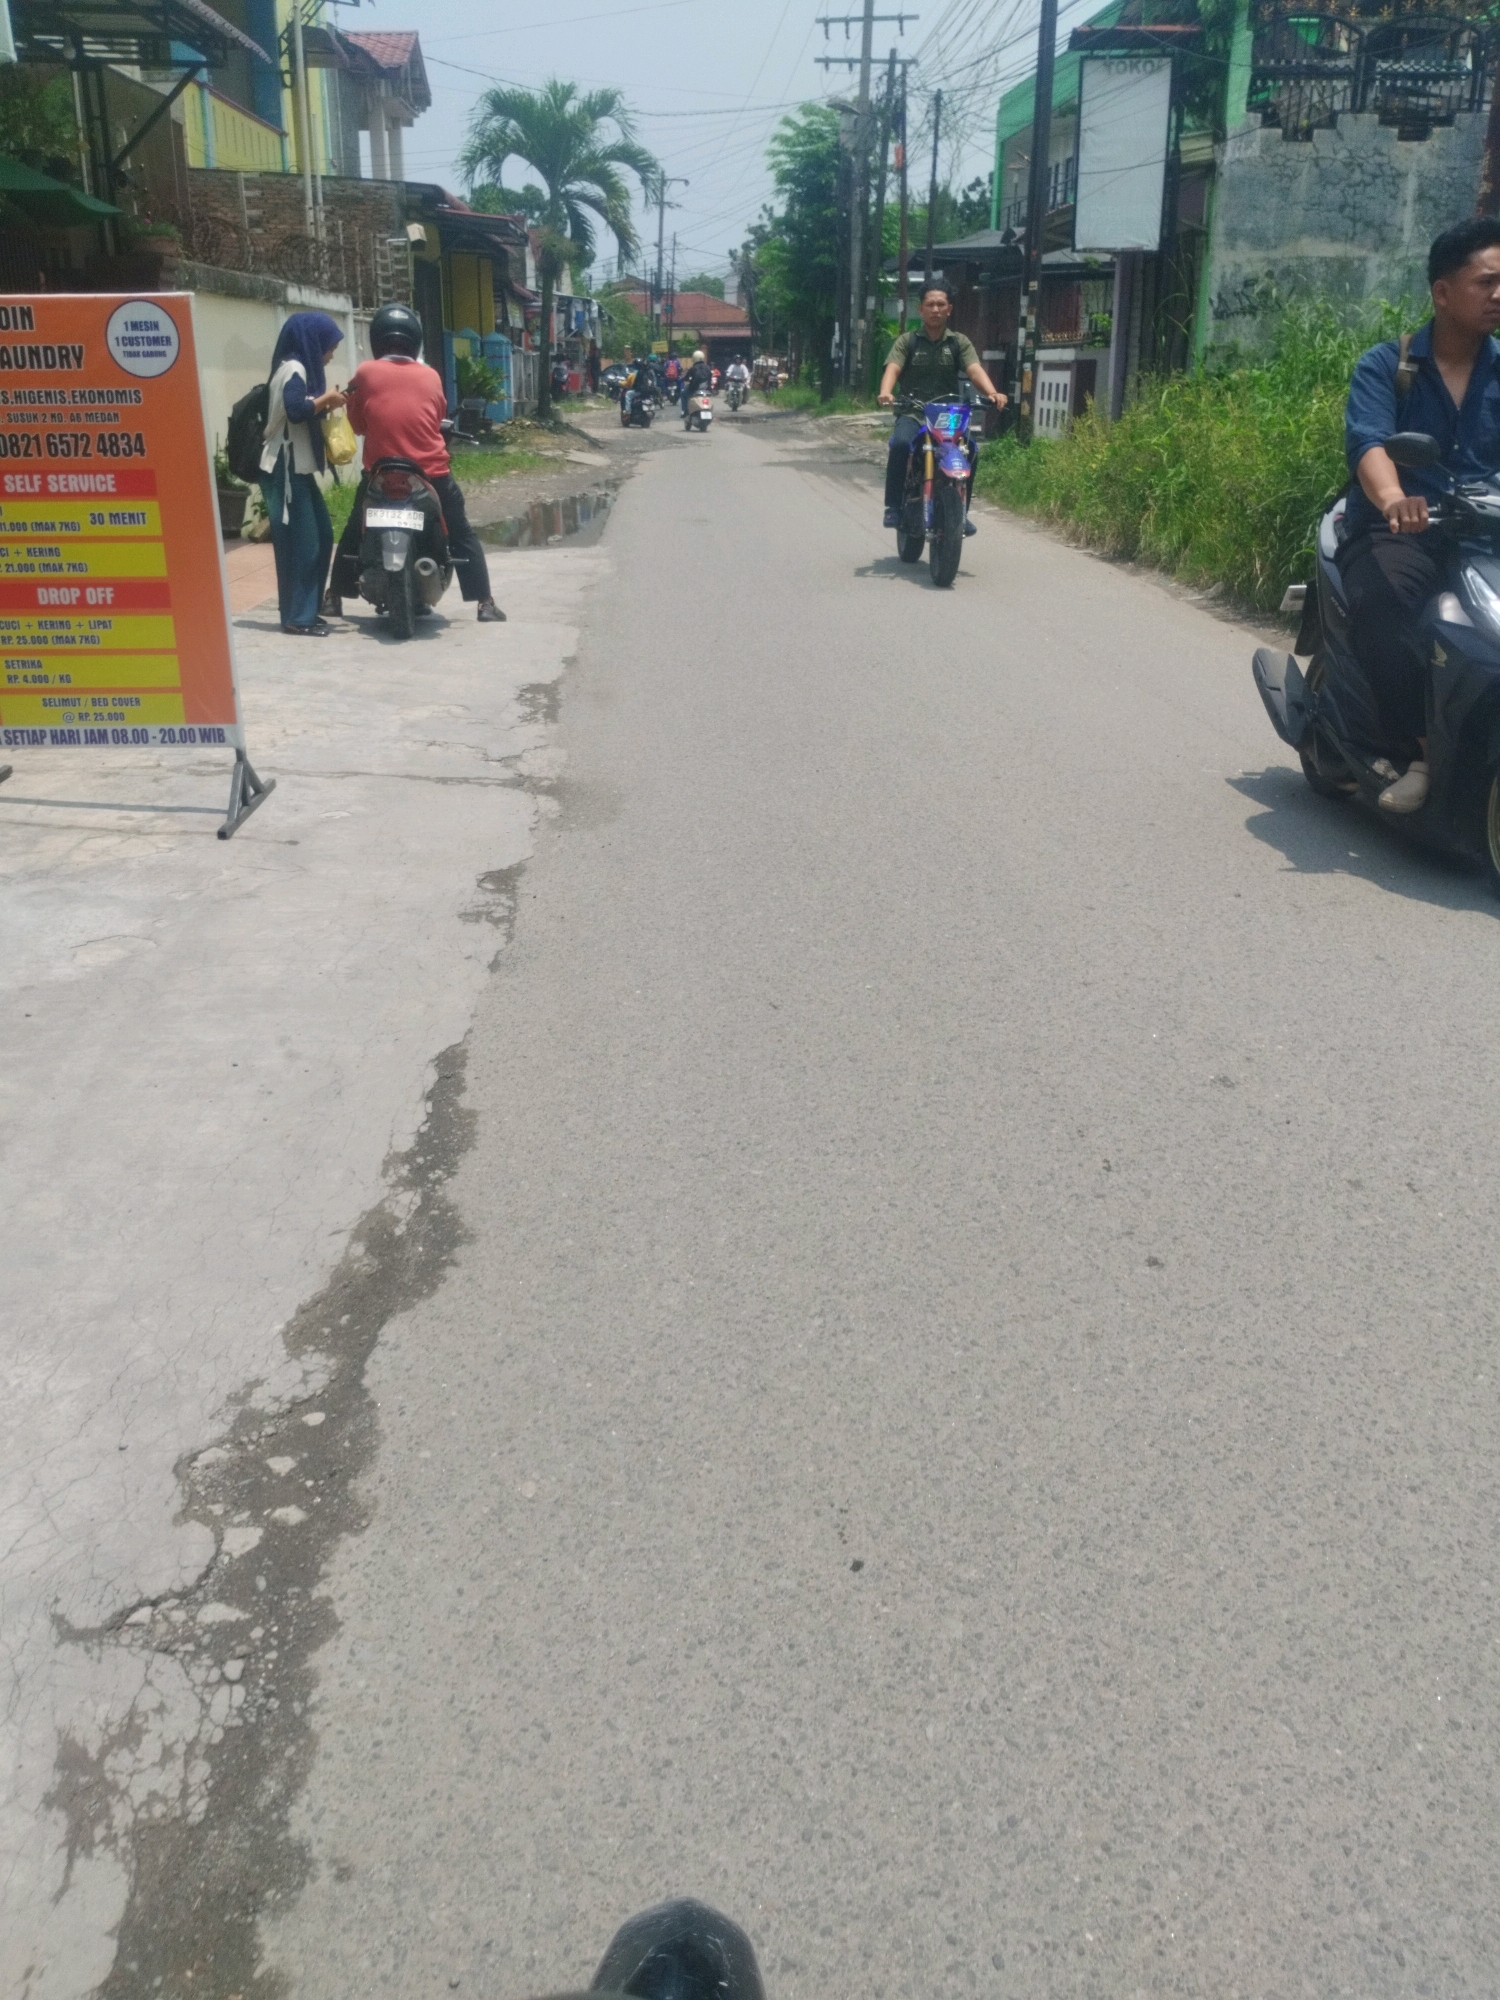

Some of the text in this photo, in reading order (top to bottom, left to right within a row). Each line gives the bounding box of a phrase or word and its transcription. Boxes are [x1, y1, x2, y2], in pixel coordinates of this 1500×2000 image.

[123, 321, 159, 331] 1 MESIN
[115, 336, 172, 347] 1 CUSTOMER
[7, 412, 38, 423] SUSUK
[41, 412, 47, 423] 2
[50, 412, 67, 423] NO.
[85, 412, 119, 423] MEDAN
[0, 432, 146, 458] 0821 6572 4834
[4, 474, 116, 492] SELF SERVICE
[89, 512, 146, 525] 30 MENIT
[58, 521, 81, 532] 7KG)
[26, 547, 61, 557] KERING
[5, 563, 35, 573] 21.000
[66, 562, 88, 573] 7KG)
[37, 587, 114, 605] DROP OFF
[0, 620, 20, 630] CUCI
[38, 620, 71, 630] KERING
[88, 620, 112, 630] LIPAT
[16, 636, 48, 645] 25.000
[79, 635, 100, 645] 7KG)
[5, 660, 43, 669] SETRIKA
[23, 675, 49, 684] 4.000
[59, 674, 71, 683] KG
[42, 698, 81, 707] SELIMUT
[92, 698, 109, 707] BED
[112, 697, 141, 707] COVER
[94, 712, 125, 721] 25.000
[3, 729, 47, 745] SETIAP
[50, 729, 81, 745] HARI
[84, 729, 109, 744] JAM
[111, 728, 149, 744] 08.00
[159, 728, 196, 744] 20.00
[198, 728, 226, 743] WIB
